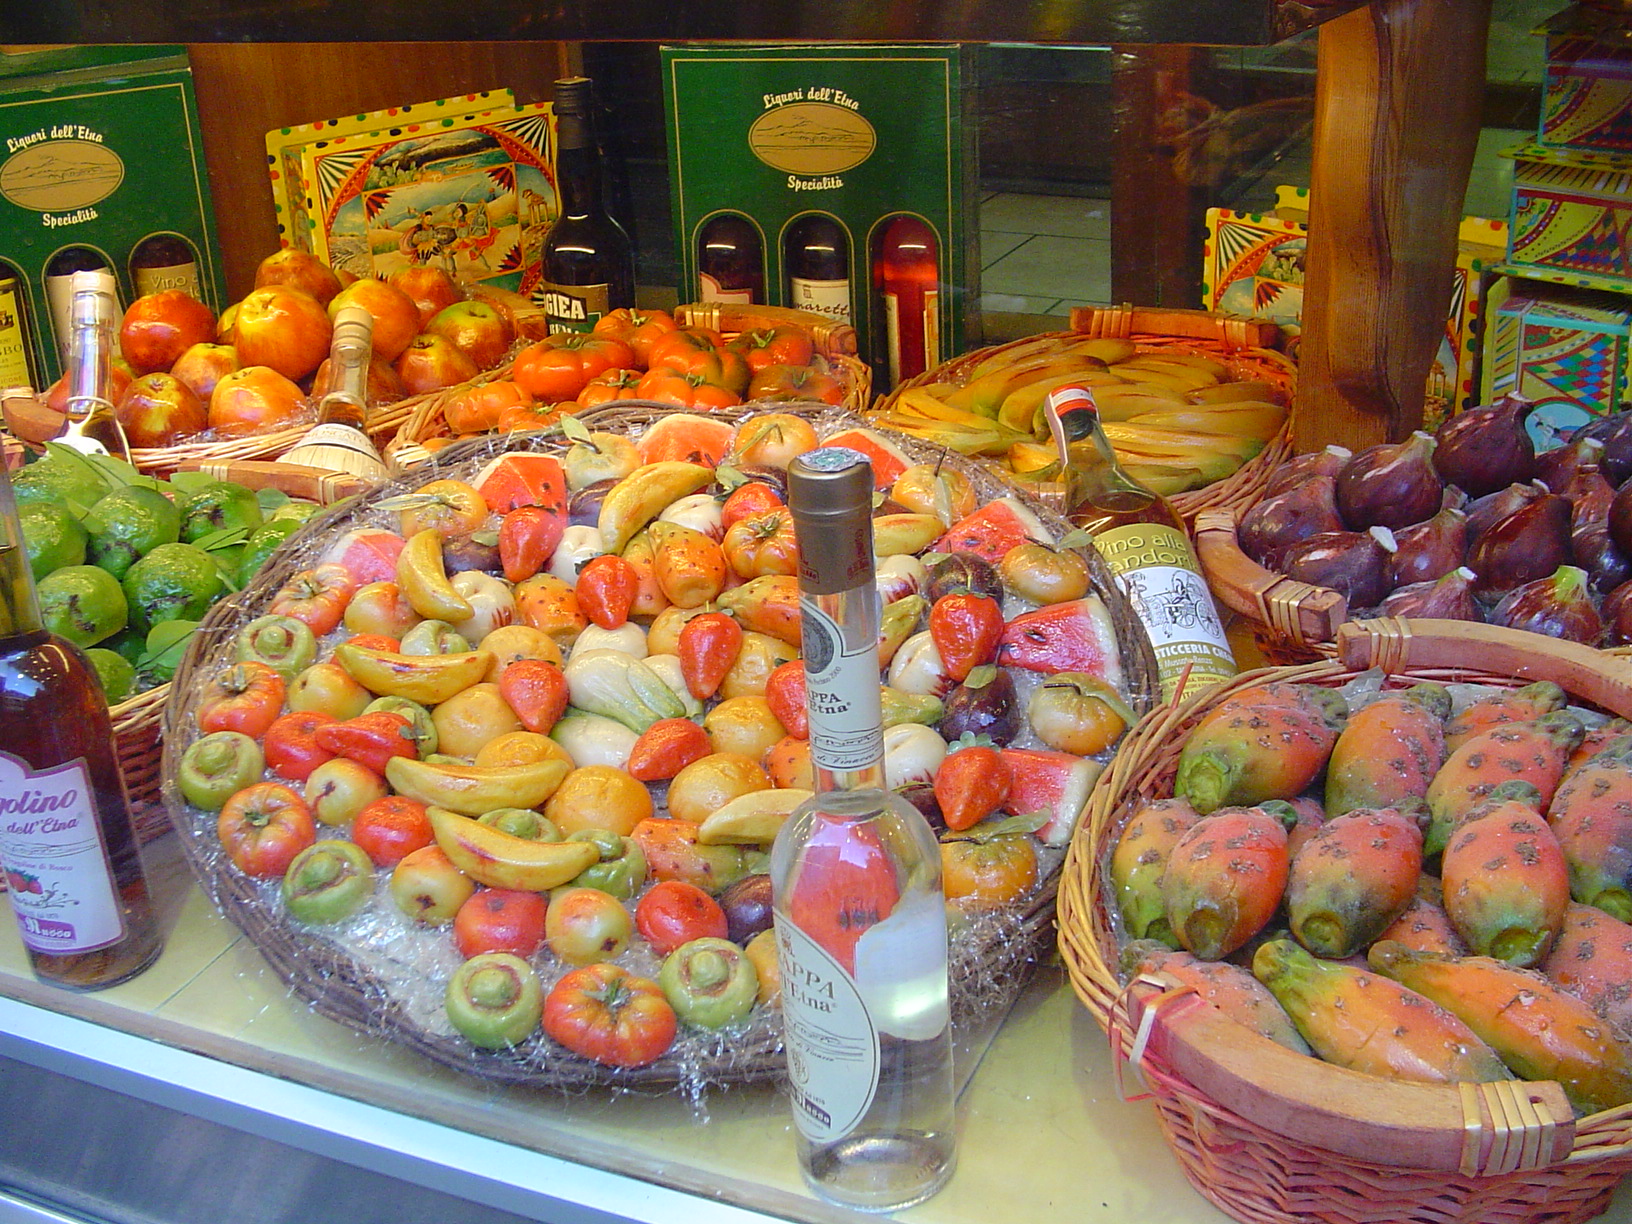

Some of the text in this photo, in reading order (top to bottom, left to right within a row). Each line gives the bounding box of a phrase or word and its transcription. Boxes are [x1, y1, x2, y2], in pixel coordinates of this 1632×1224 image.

[763, 86, 860, 110] Liquori dell'Etna
[6, 124, 103, 153] Liquori dell'Etna
[787, 175, 844, 192] Specialità
[42, 207, 98, 229] Specialità
[1150, 532, 1187, 553] alla
